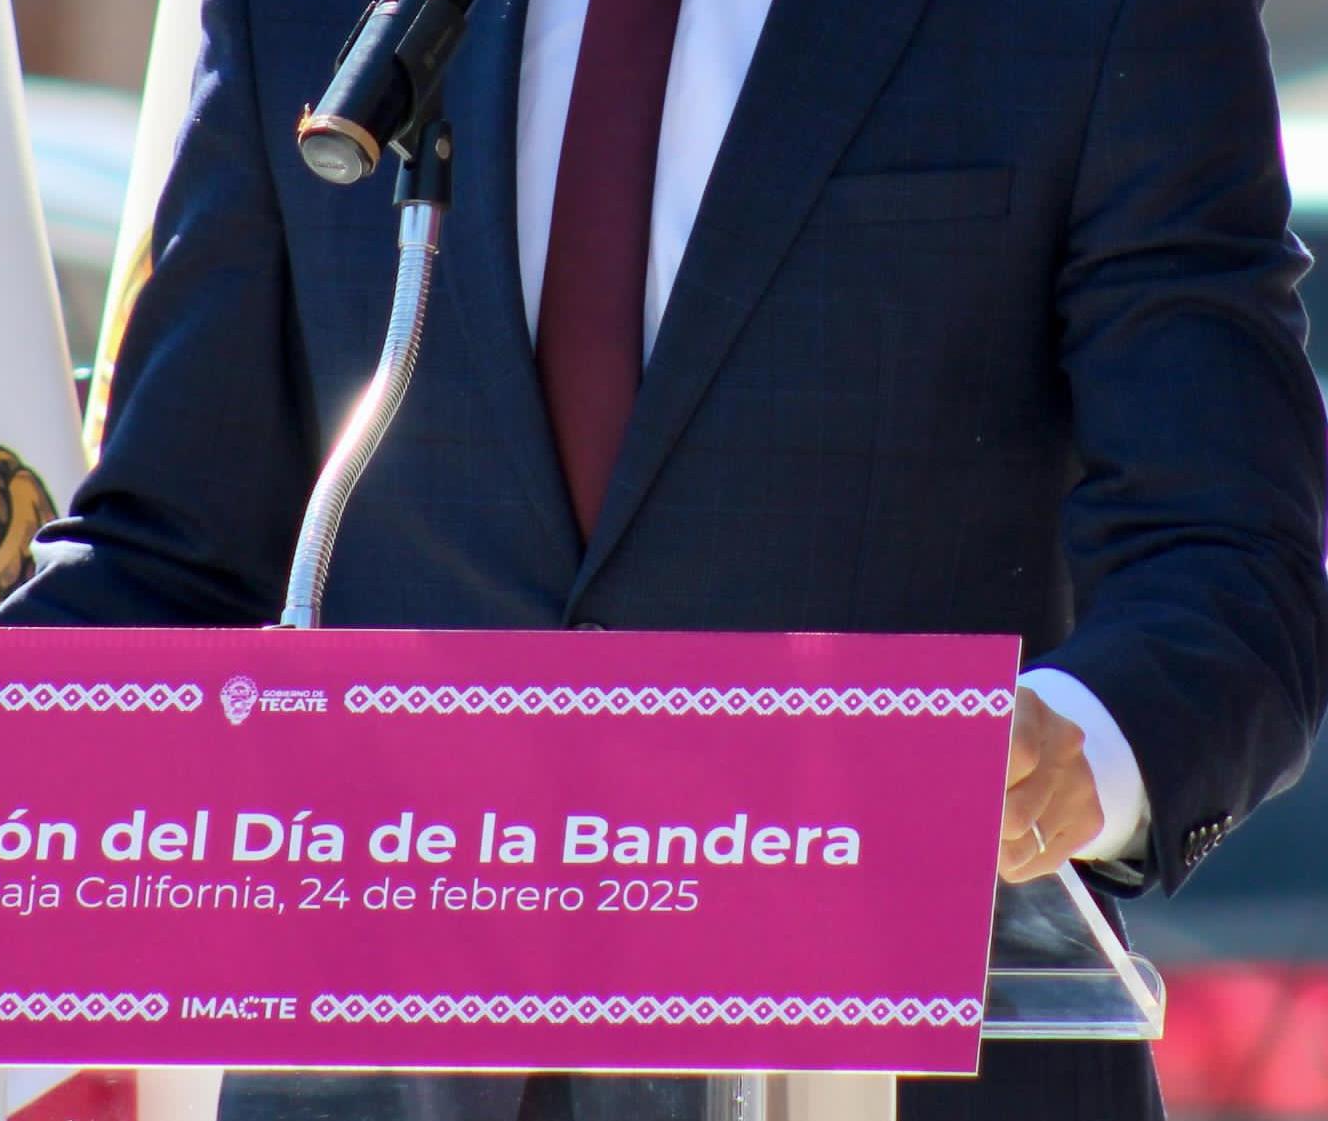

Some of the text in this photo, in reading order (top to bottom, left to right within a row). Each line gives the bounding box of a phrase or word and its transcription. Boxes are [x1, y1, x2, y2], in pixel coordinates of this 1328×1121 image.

[258, 698, 329, 712] TECATE
[100, 809, 209, 862] del
[231, 810, 345, 863] Día
[368, 811, 457, 864] de
[479, 812, 537, 864] la
[562, 813, 861, 866] Bandera
[75, 874, 286, 915] California,
[298, 877, 351, 910] 24
[362, 876, 417, 911] de
[429, 877, 584, 912] febrero
[596, 879, 700, 912] 2025
[180, 995, 297, 1020] IMACTE
